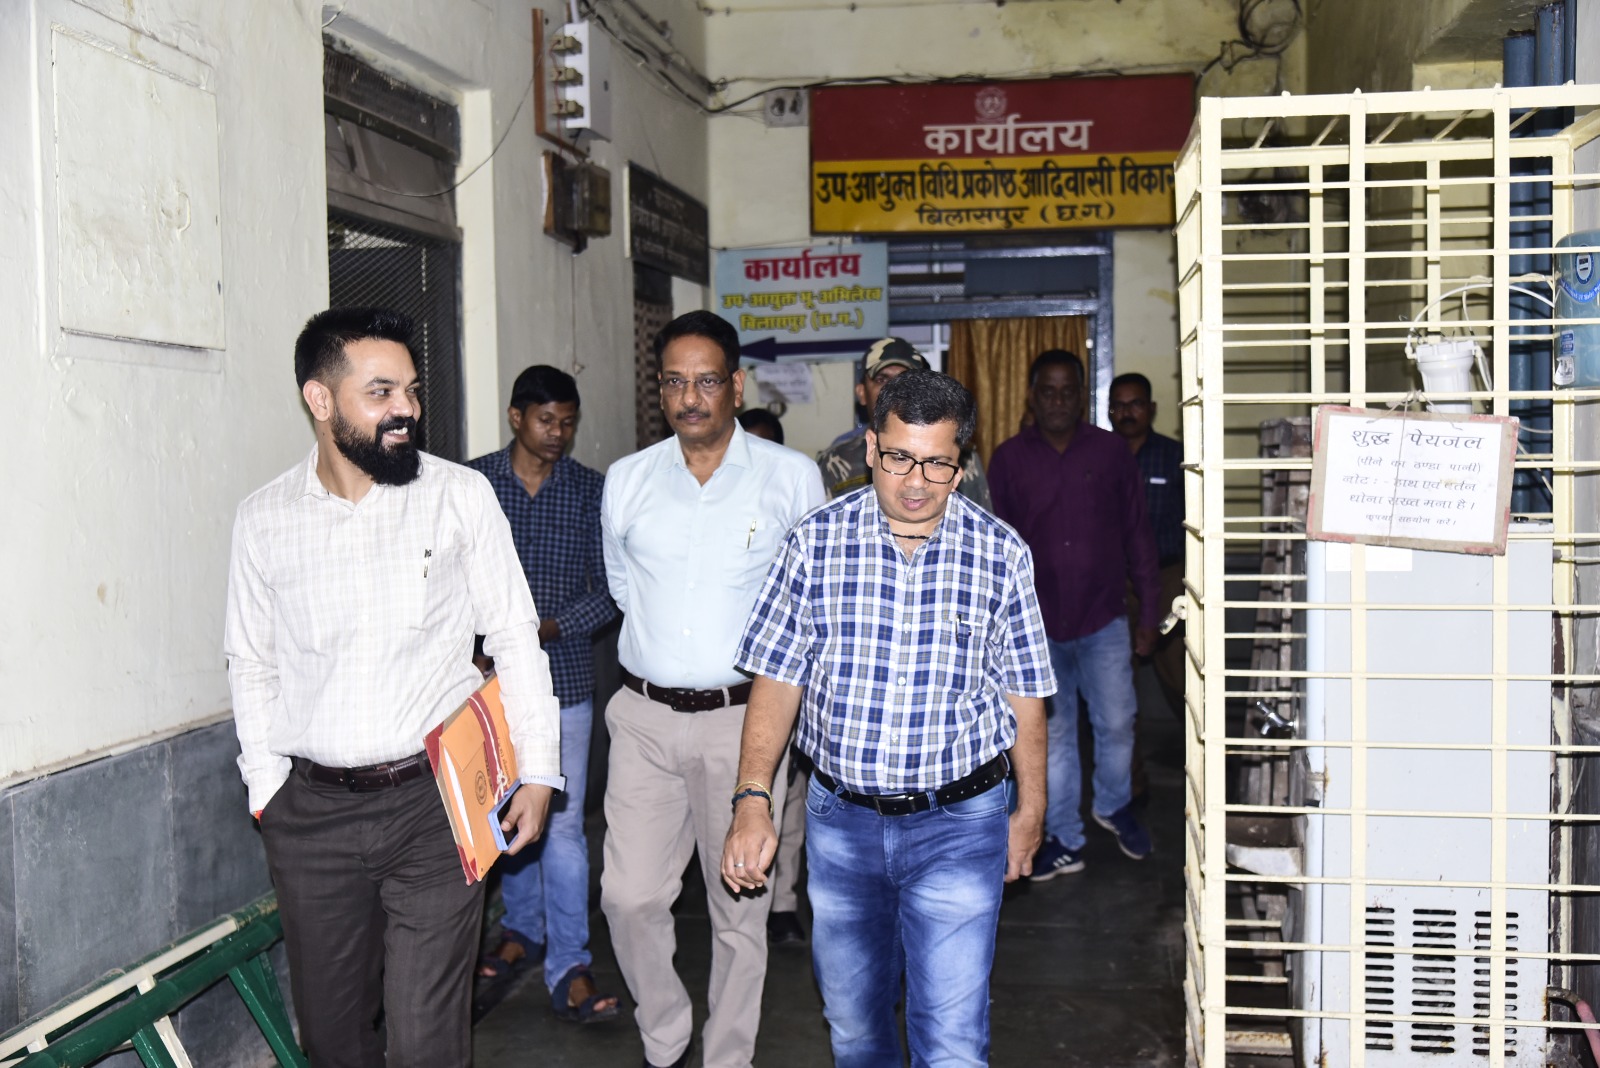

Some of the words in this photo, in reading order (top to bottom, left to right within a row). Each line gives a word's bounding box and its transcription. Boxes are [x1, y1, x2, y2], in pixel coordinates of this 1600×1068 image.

[923, 114, 1093, 154] कार्यालय
[919, 162, 959, 199] विधि
[961, 160, 1017, 200] प्रकोष्ठ
[1019, 157, 1116, 200] आदिवासी
[915, 201, 1029, 229] बिलासपुर
[743, 249, 862, 281] कार्यालय
[739, 313, 807, 333] बिलासपुर
[1351, 429, 1393, 447] शुद्ध
[1408, 428, 1485, 449] पेयजल
[1390, 460, 1406, 468] का
[1349, 493, 1383, 505] धोना
[1423, 499, 1452, 509] मना
[1398, 514, 1430, 524] सहयोग
